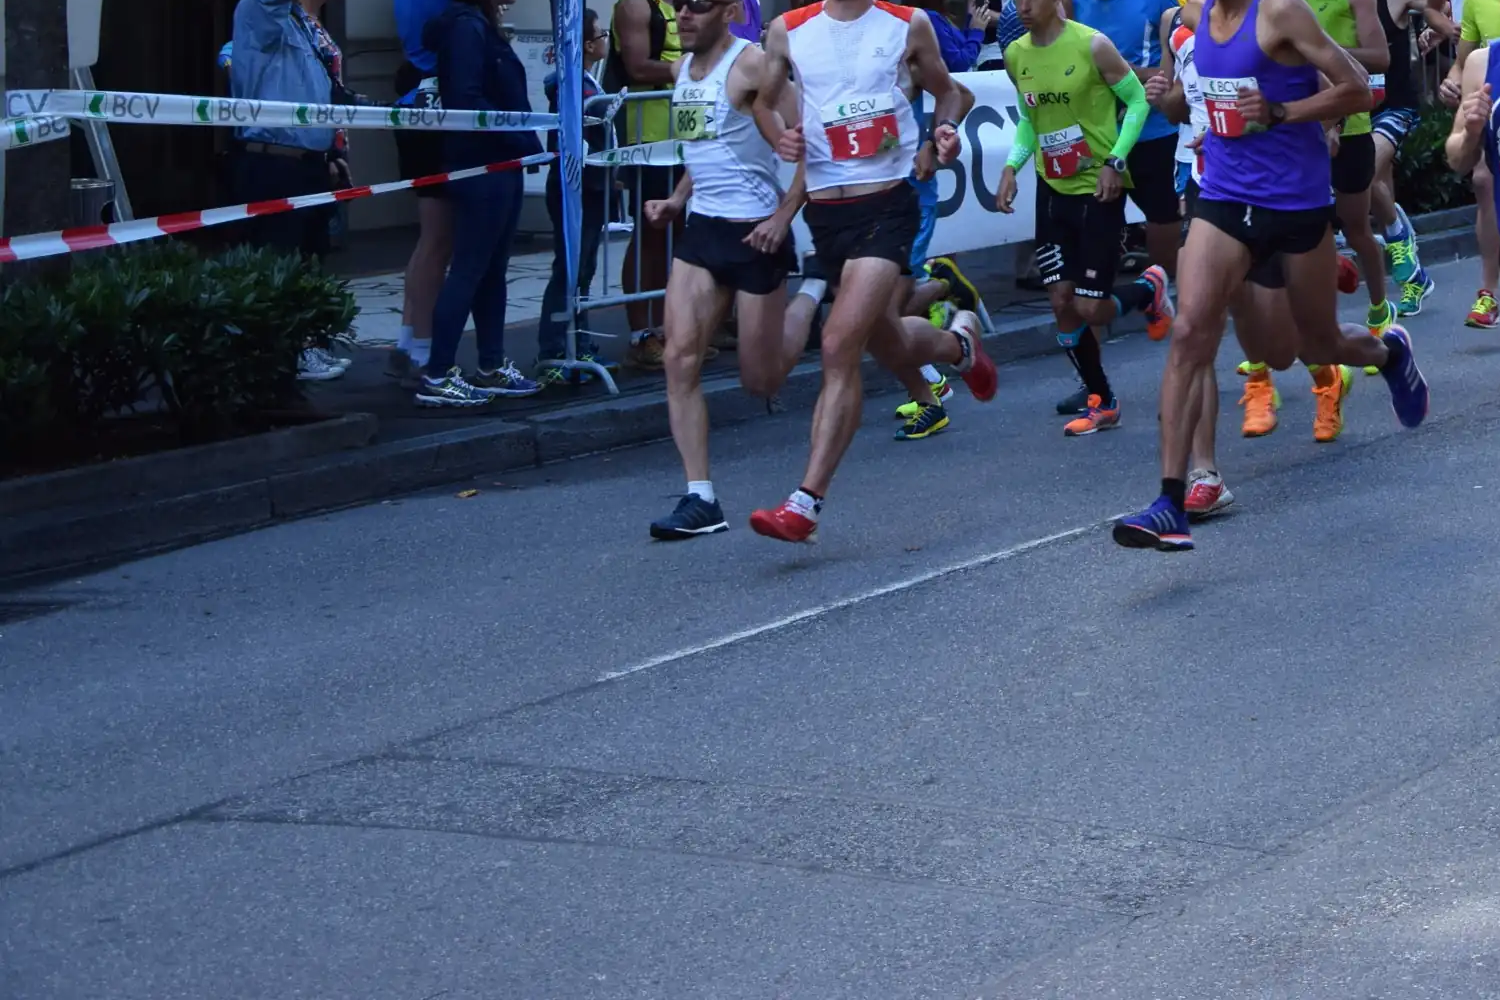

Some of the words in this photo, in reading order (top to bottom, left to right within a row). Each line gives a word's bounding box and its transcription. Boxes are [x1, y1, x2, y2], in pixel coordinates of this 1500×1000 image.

[687, 88, 706, 100] BCV
[1218, 81, 1240, 93] BCV
[5, 92, 50, 118] CV
[113, 94, 160, 119] BCV
[218, 99, 262, 122] BCV
[317, 103, 359, 125] BCV
[849, 98, 877, 115] BCV
[36, 115, 68, 138] BC
[409, 109, 447, 127] BCV
[494, 111, 532, 127] BCV
[677, 110, 697, 132] 806
[1213, 110, 1228, 134] 11
[848, 132, 860, 155] 5
[1049, 131, 1068, 144] BCV
[620, 146, 653, 163] BCV
[1053, 157, 1062, 176] 4
